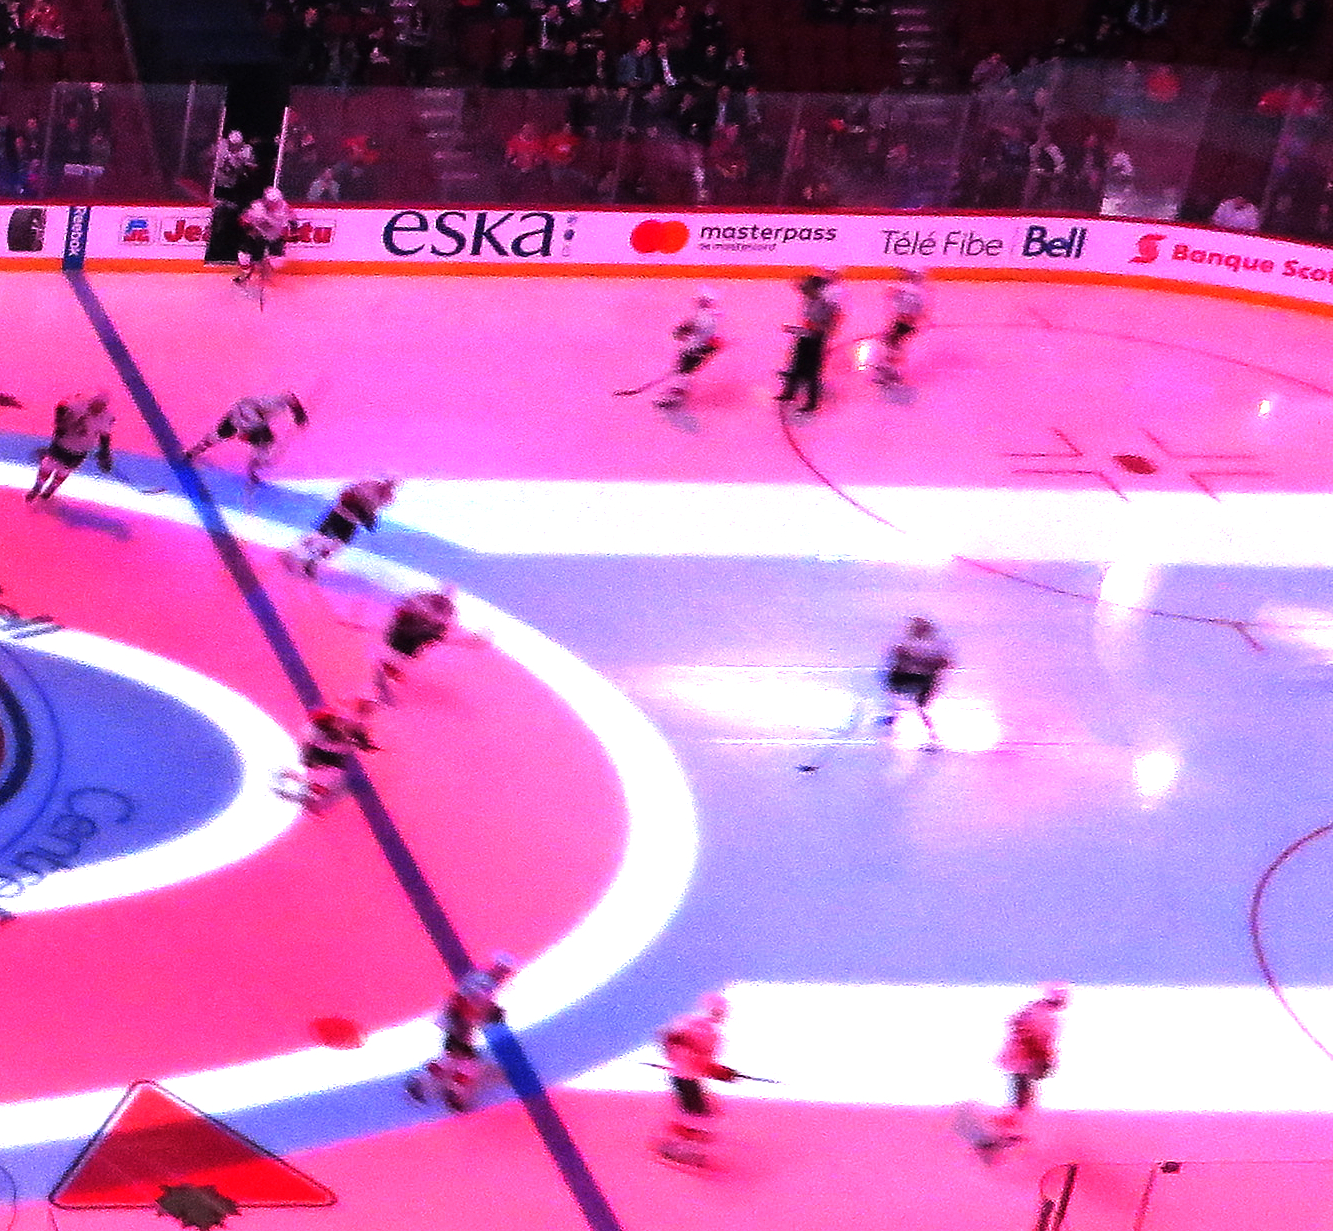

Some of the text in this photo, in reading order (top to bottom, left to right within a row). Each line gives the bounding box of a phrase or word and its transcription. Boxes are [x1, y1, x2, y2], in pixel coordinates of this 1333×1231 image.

[67, 207, 88, 256] Reebok
[382, 209, 556, 257] eska
[700, 225, 838, 243] masterpass
[882, 229, 1004, 257] Télé Fibe
[1022, 225, 1088, 258] Bell
[1172, 244, 1275, 273] Banque
